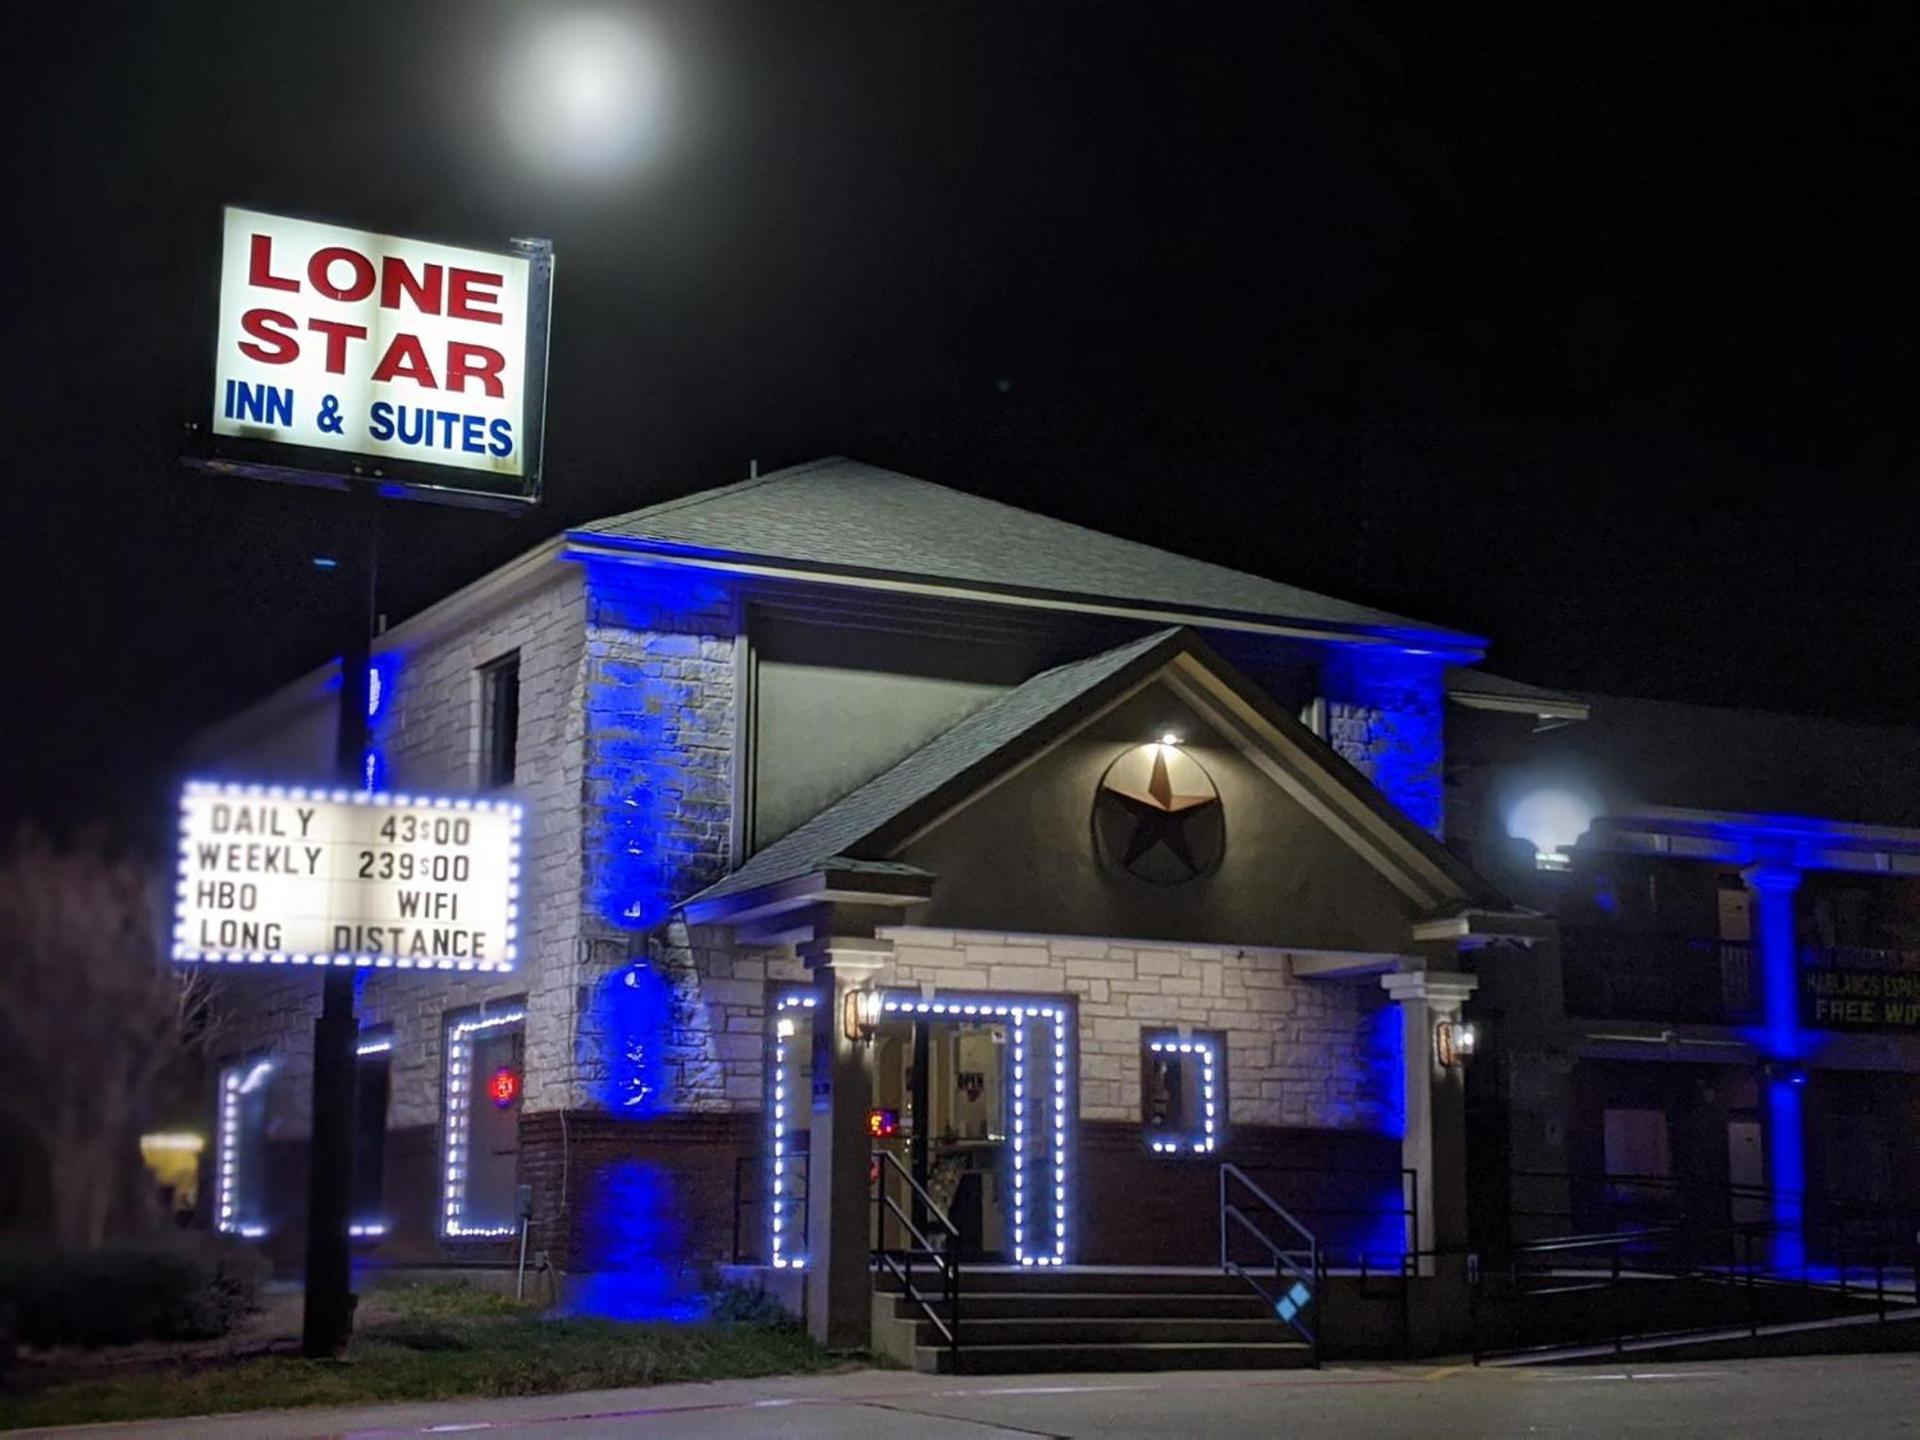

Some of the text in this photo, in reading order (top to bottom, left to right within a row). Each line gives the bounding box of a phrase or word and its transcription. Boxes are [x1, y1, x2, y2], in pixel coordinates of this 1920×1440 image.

[248, 233, 504, 326] LONE
[237, 307, 506, 400] STAR
[224, 379, 514, 458] INN & SUITES
[210, 803, 315, 838] DAILY
[197, 843, 323, 876] WEEKLY
[196, 880, 459, 921] HBO WIFI
[200, 919, 487, 959] LONG DISTANCE
[1815, 998, 1874, 1023] FREE
